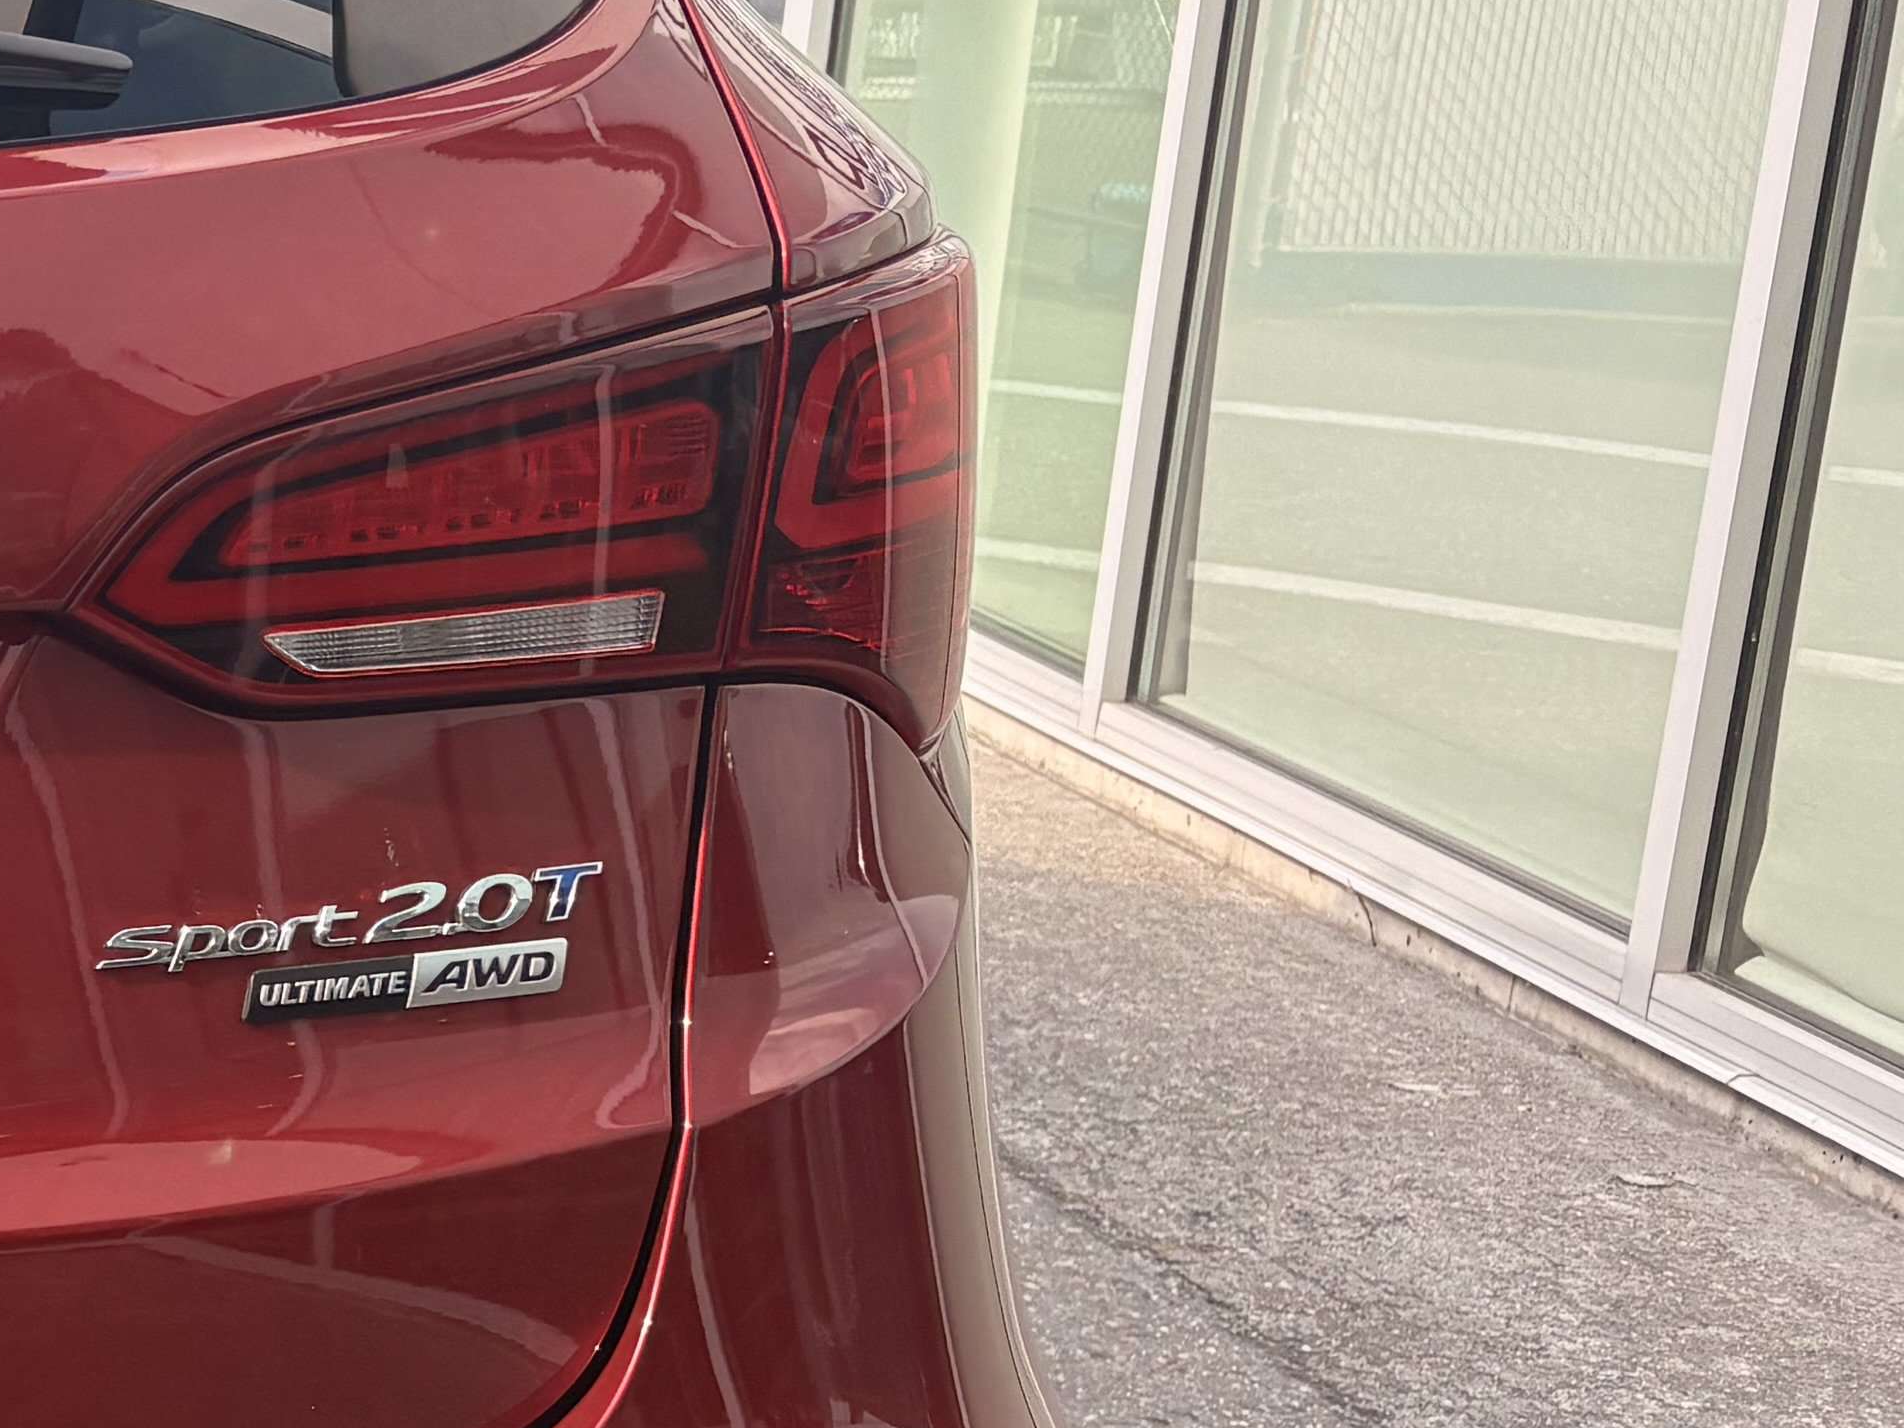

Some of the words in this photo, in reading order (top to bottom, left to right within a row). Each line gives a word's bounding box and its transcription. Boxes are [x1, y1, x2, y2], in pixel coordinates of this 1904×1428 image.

[95, 903, 359, 972] sport
[258, 970, 408, 1007] ULTIMATE
[421, 951, 556, 994] AWD
